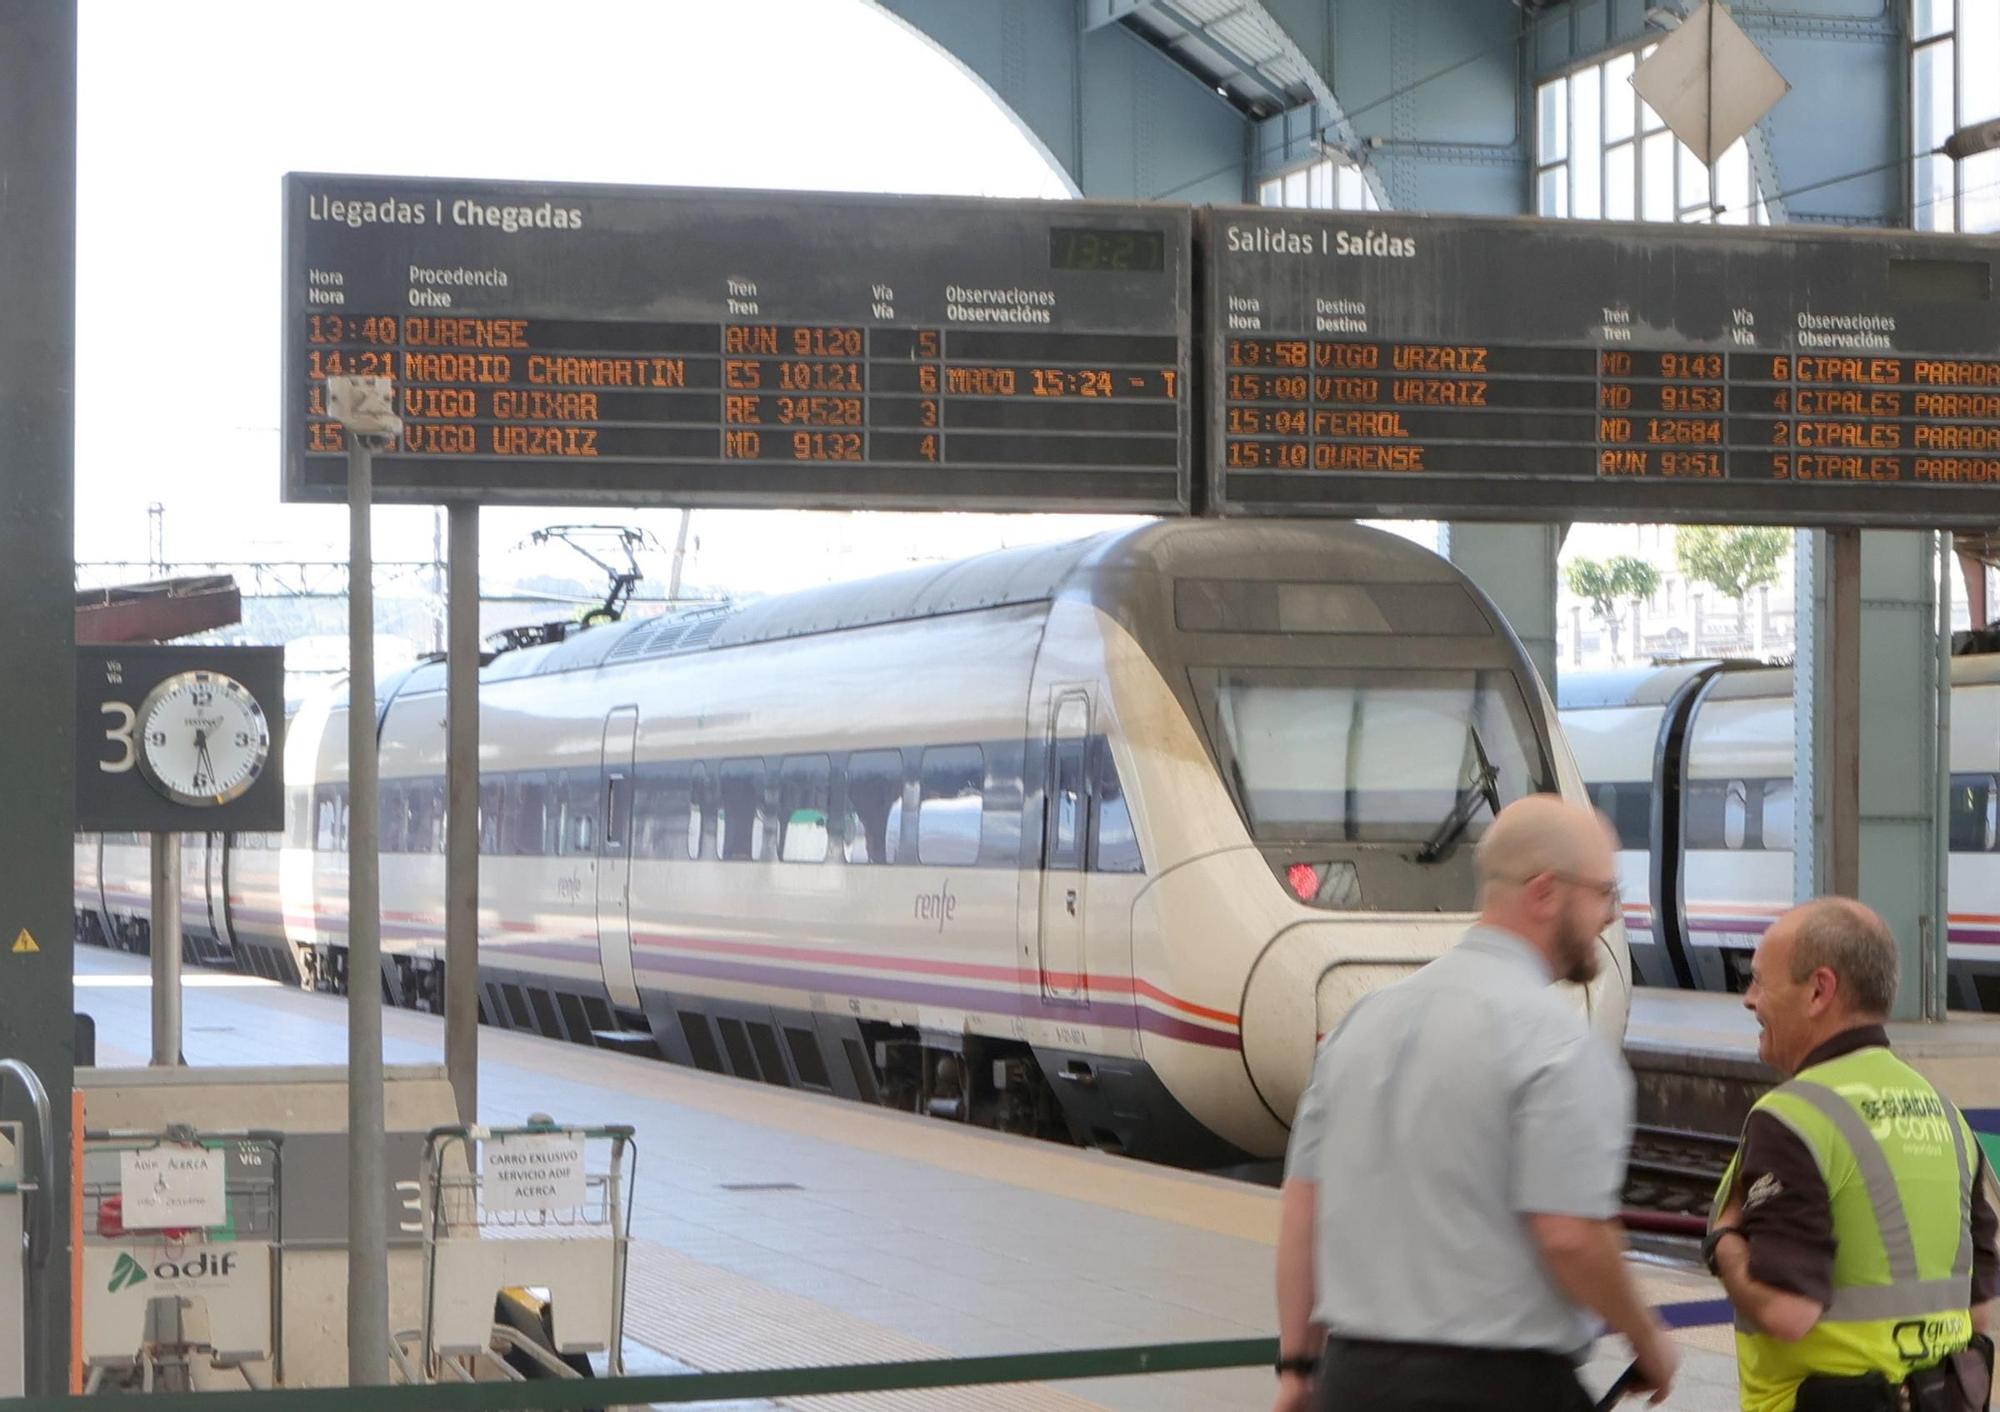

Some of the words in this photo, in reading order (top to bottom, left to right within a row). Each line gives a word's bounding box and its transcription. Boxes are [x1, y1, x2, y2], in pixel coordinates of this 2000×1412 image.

[309, 194, 426, 228] Llegadas
[452, 199, 583, 233] Chegadas
[1227, 225, 1314, 254] Salidas
[1335, 228, 1416, 258] Saídas
[308, 268, 344, 286] Hora
[409, 264, 508, 287] Procedencia
[308, 288, 345, 305] Hora
[409, 288, 452, 308] Orixe
[727, 279, 757, 297] Tren
[946, 284, 1056, 306] Observaciones
[727, 298, 759, 316] Tren
[946, 303, 1051, 324] Observacións
[1228, 295, 1261, 313] Hora
[1316, 297, 1366, 316] Destino
[1228, 312, 1261, 330] Hora
[1316, 315, 1368, 333] Destino
[1602, 307, 1630, 324] Tren
[1797, 311, 1896, 331] Observaciones
[308, 314, 397, 345] 13:40
[405, 318, 529, 349] OURENSE
[793, 328, 862, 356] 9120
[918, 331, 937, 358] 5
[1602, 325, 1632, 341] Tren
[1797, 330, 1892, 348] Observacións
[1229, 339, 1309, 369] 13:58
[1315, 344, 1380, 370] VIGO
[1393, 346, 1489, 373] URZAIZ
[1600, 351, 1632, 377] MD
[1660, 353, 1722, 379] 9143
[1771, 355, 1790, 381] 6
[1796, 356, 1900, 384] CIPALES
[1913, 359, 2000, 386] PARADA
[308, 350, 398, 379] 14:21
[405, 354, 511, 384] MADRID
[528, 355, 685, 387] CHAMARTIN
[725, 359, 761, 389] ES
[778, 362, 863, 392] 10121
[918, 364, 937, 394] 6
[1030, 368, 1113, 399] 15:24
[1229, 373, 1308, 401] 15:00
[1315, 377, 1380, 403] VIGO
[1393, 379, 1489, 406] URZAIZ
[1600, 385, 1632, 410] MD
[1660, 385, 1722, 411] 9153
[1773, 387, 1788, 412] 4
[1796, 390, 1900, 417] CIPALES
[1913, 393, 2000, 419] PARADA
[404, 387, 478, 418] VIGO
[493, 390, 599, 422] GUIXAR
[725, 395, 761, 424] RE
[777, 397, 862, 426] 34528
[919, 398, 937, 428] 3
[1229, 407, 1306, 434] 15:04
[1314, 411, 1409, 438] FERROL
[1600, 417, 1632, 443] MD
[1647, 418, 1722, 445] 12684
[1772, 421, 1790, 446] 2
[1796, 422, 1901, 450] CIPALES
[1913, 424, 2000, 451] PARADA
[404, 423, 477, 453] VIGO
[493, 425, 600, 457] URZAIZ
[725, 430, 761, 459] MD
[793, 431, 863, 461] 9132
[919, 432, 937, 463] 4
[1229, 441, 1308, 468] 15:10
[1314, 445, 1425, 473] OURENSE
[1660, 451, 1722, 478] 9351
[1772, 454, 1790, 480] 5
[1796, 455, 1900, 482] CIPALES
[1913, 457, 2000, 483] PARADA
[191, 691, 213, 708] 12
[100, 701, 138, 773] 3
[151, 732, 167, 748] 9
[234, 731, 250, 748] 3
[192, 773, 208, 789] 6
[914, 878, 956, 934] renfe
[489, 1153, 527, 1166] CARRO
[529, 1150, 578, 1164] EXLUSIVO
[498, 1169, 547, 1181] SERVICIO
[515, 1186, 557, 1198] ACERCA
[154, 1251, 237, 1280] adif
